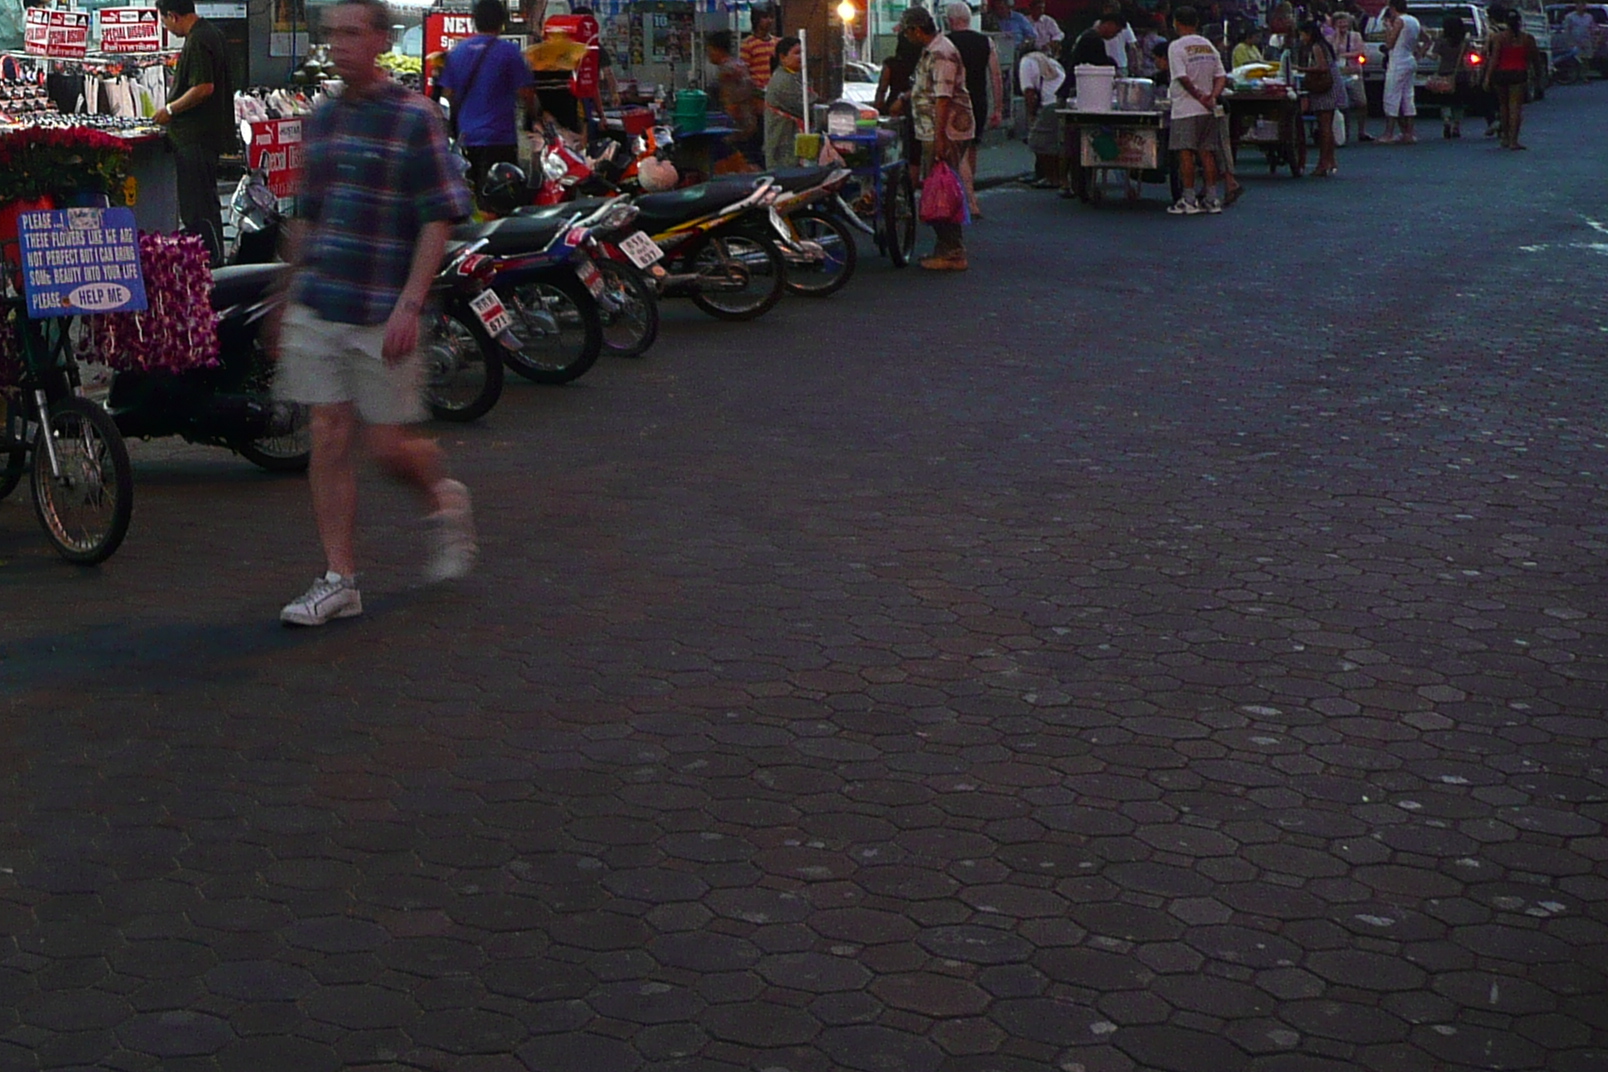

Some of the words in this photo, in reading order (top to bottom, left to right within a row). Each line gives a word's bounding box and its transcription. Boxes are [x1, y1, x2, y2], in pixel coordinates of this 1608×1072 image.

[21, 213, 52, 230] PLEASE
[24, 232, 49, 248] THESE
[52, 229, 85, 247] FLOWERS
[88, 227, 103, 245] LIKE
[120, 227, 133, 243] ARE
[27, 251, 43, 267] NOT
[46, 249, 78, 266] PERFECT
[79, 247, 94, 263] BUT
[99, 247, 114, 262] CAN
[115, 245, 135, 261] BRING
[29, 269, 52, 286] SOME
[53, 266, 81, 284] BEAUTY
[84, 266, 101, 281] INTO
[103, 264, 121, 280] YOUR
[122, 263, 138, 279] LIFE
[32, 292, 61, 310] PLEASE
[78, 288, 104, 305] HELP
[108, 287, 123, 303] ME
